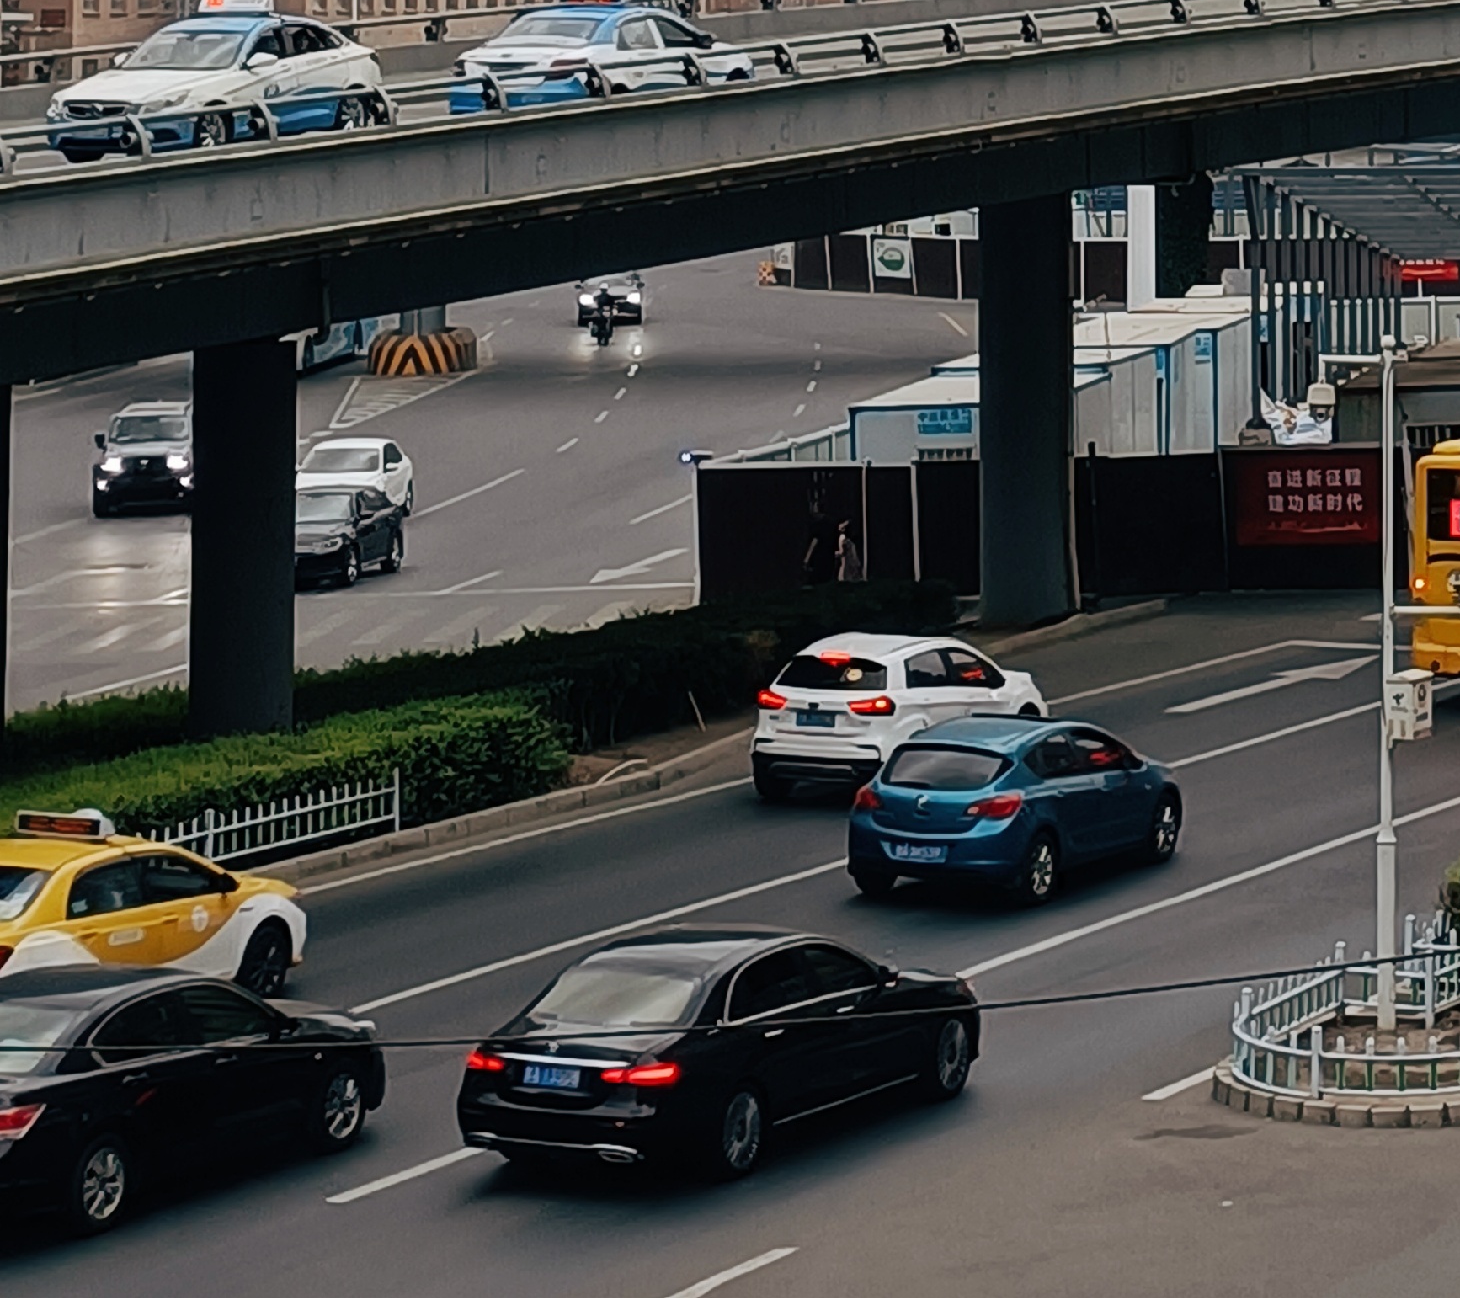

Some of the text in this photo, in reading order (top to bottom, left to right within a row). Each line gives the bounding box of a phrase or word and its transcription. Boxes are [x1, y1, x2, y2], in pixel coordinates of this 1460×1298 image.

[1267, 468, 1362, 488] 奋进新征程
[1268, 493, 1363, 512] 建功新时代
